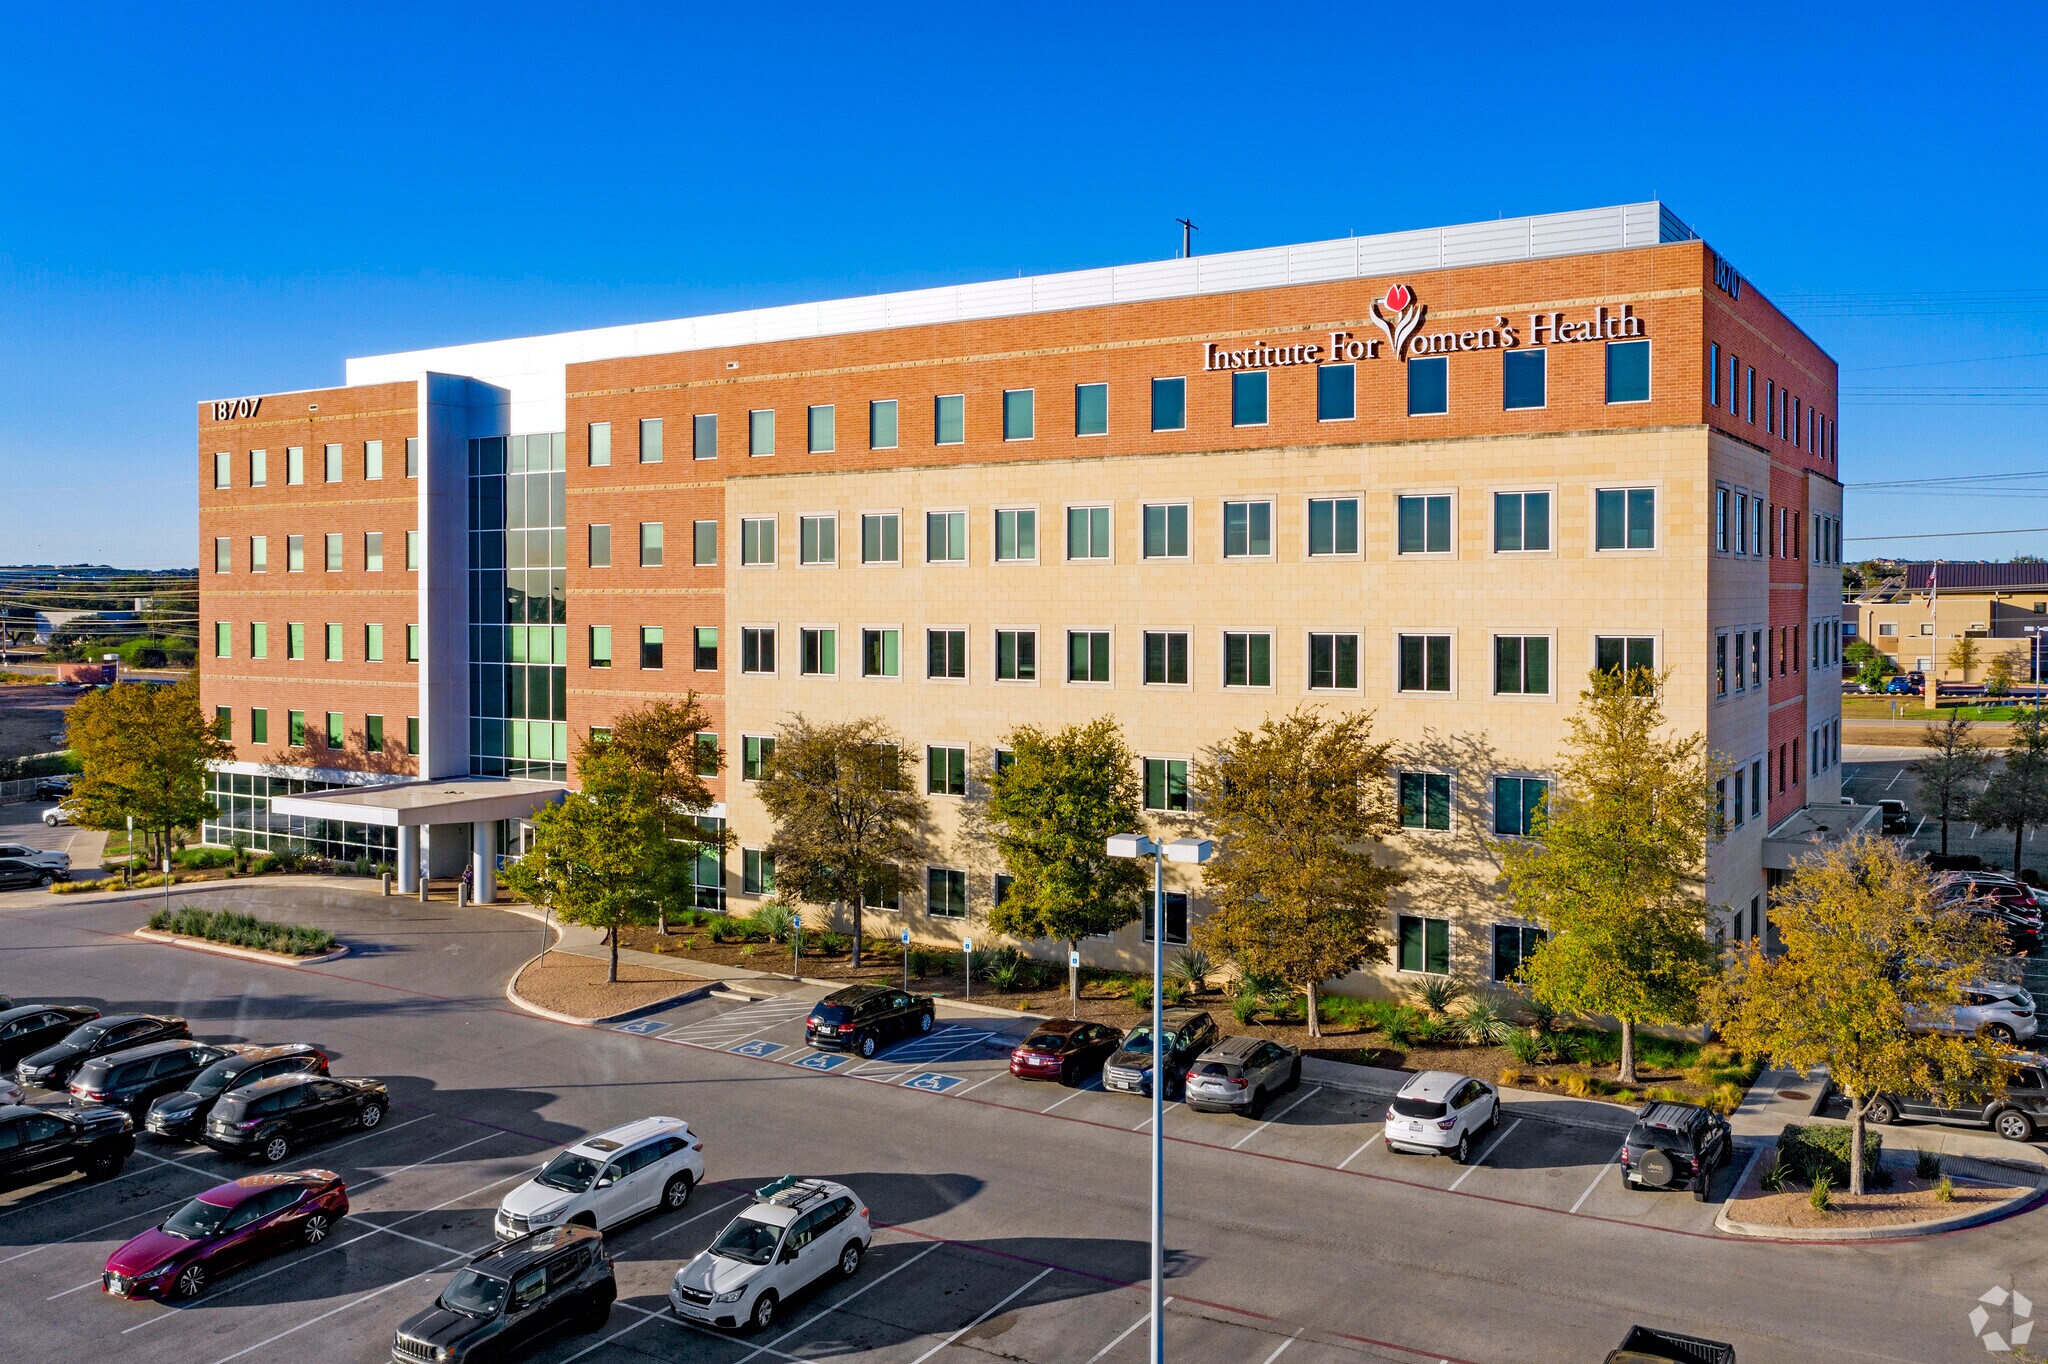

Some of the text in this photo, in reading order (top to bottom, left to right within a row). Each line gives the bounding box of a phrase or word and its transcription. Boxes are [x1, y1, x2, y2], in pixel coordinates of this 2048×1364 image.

[1714, 255, 1742, 301] 18707
[1202, 340, 1319, 371] Institute
[1328, 331, 1378, 362] For
[1528, 304, 1641, 345] Health
[211, 398, 260, 421] 18707
